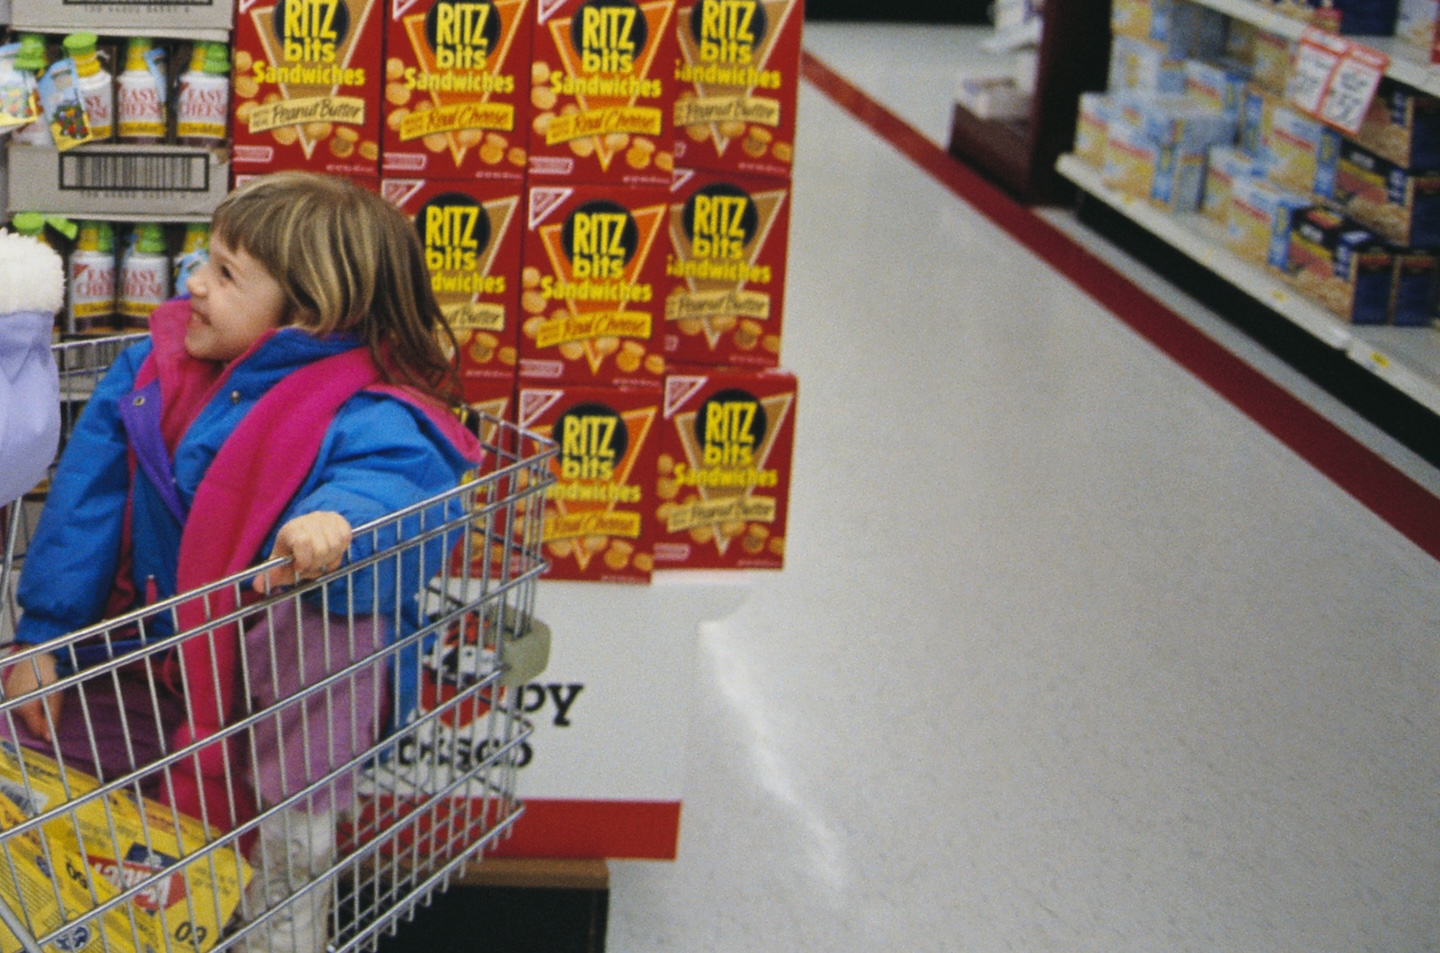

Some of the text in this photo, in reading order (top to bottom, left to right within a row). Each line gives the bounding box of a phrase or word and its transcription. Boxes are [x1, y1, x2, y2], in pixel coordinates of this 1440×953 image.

[435, 1, 490, 47] RITZ
[581, 4, 637, 50] RITZ
[283, 38, 336, 63] bits
[435, 45, 487, 70] bits
[581, 49, 633, 74] bits
[700, 38, 753, 65] bits
[272, 102, 319, 124] Peanut
[319, 99, 361, 118] Butter
[426, 205, 480, 249] RITZ
[693, 193, 748, 239] RITZ
[573, 211, 627, 256] RITZ
[692, 233, 744, 260] bits
[426, 247, 479, 272] bits
[572, 254, 625, 279] bits
[430, 272, 506, 295] dwiches
[705, 401, 758, 443] RITZ
[563, 414, 618, 458] RITZ
[703, 441, 753, 467] bits
[561, 455, 614, 480] bits
